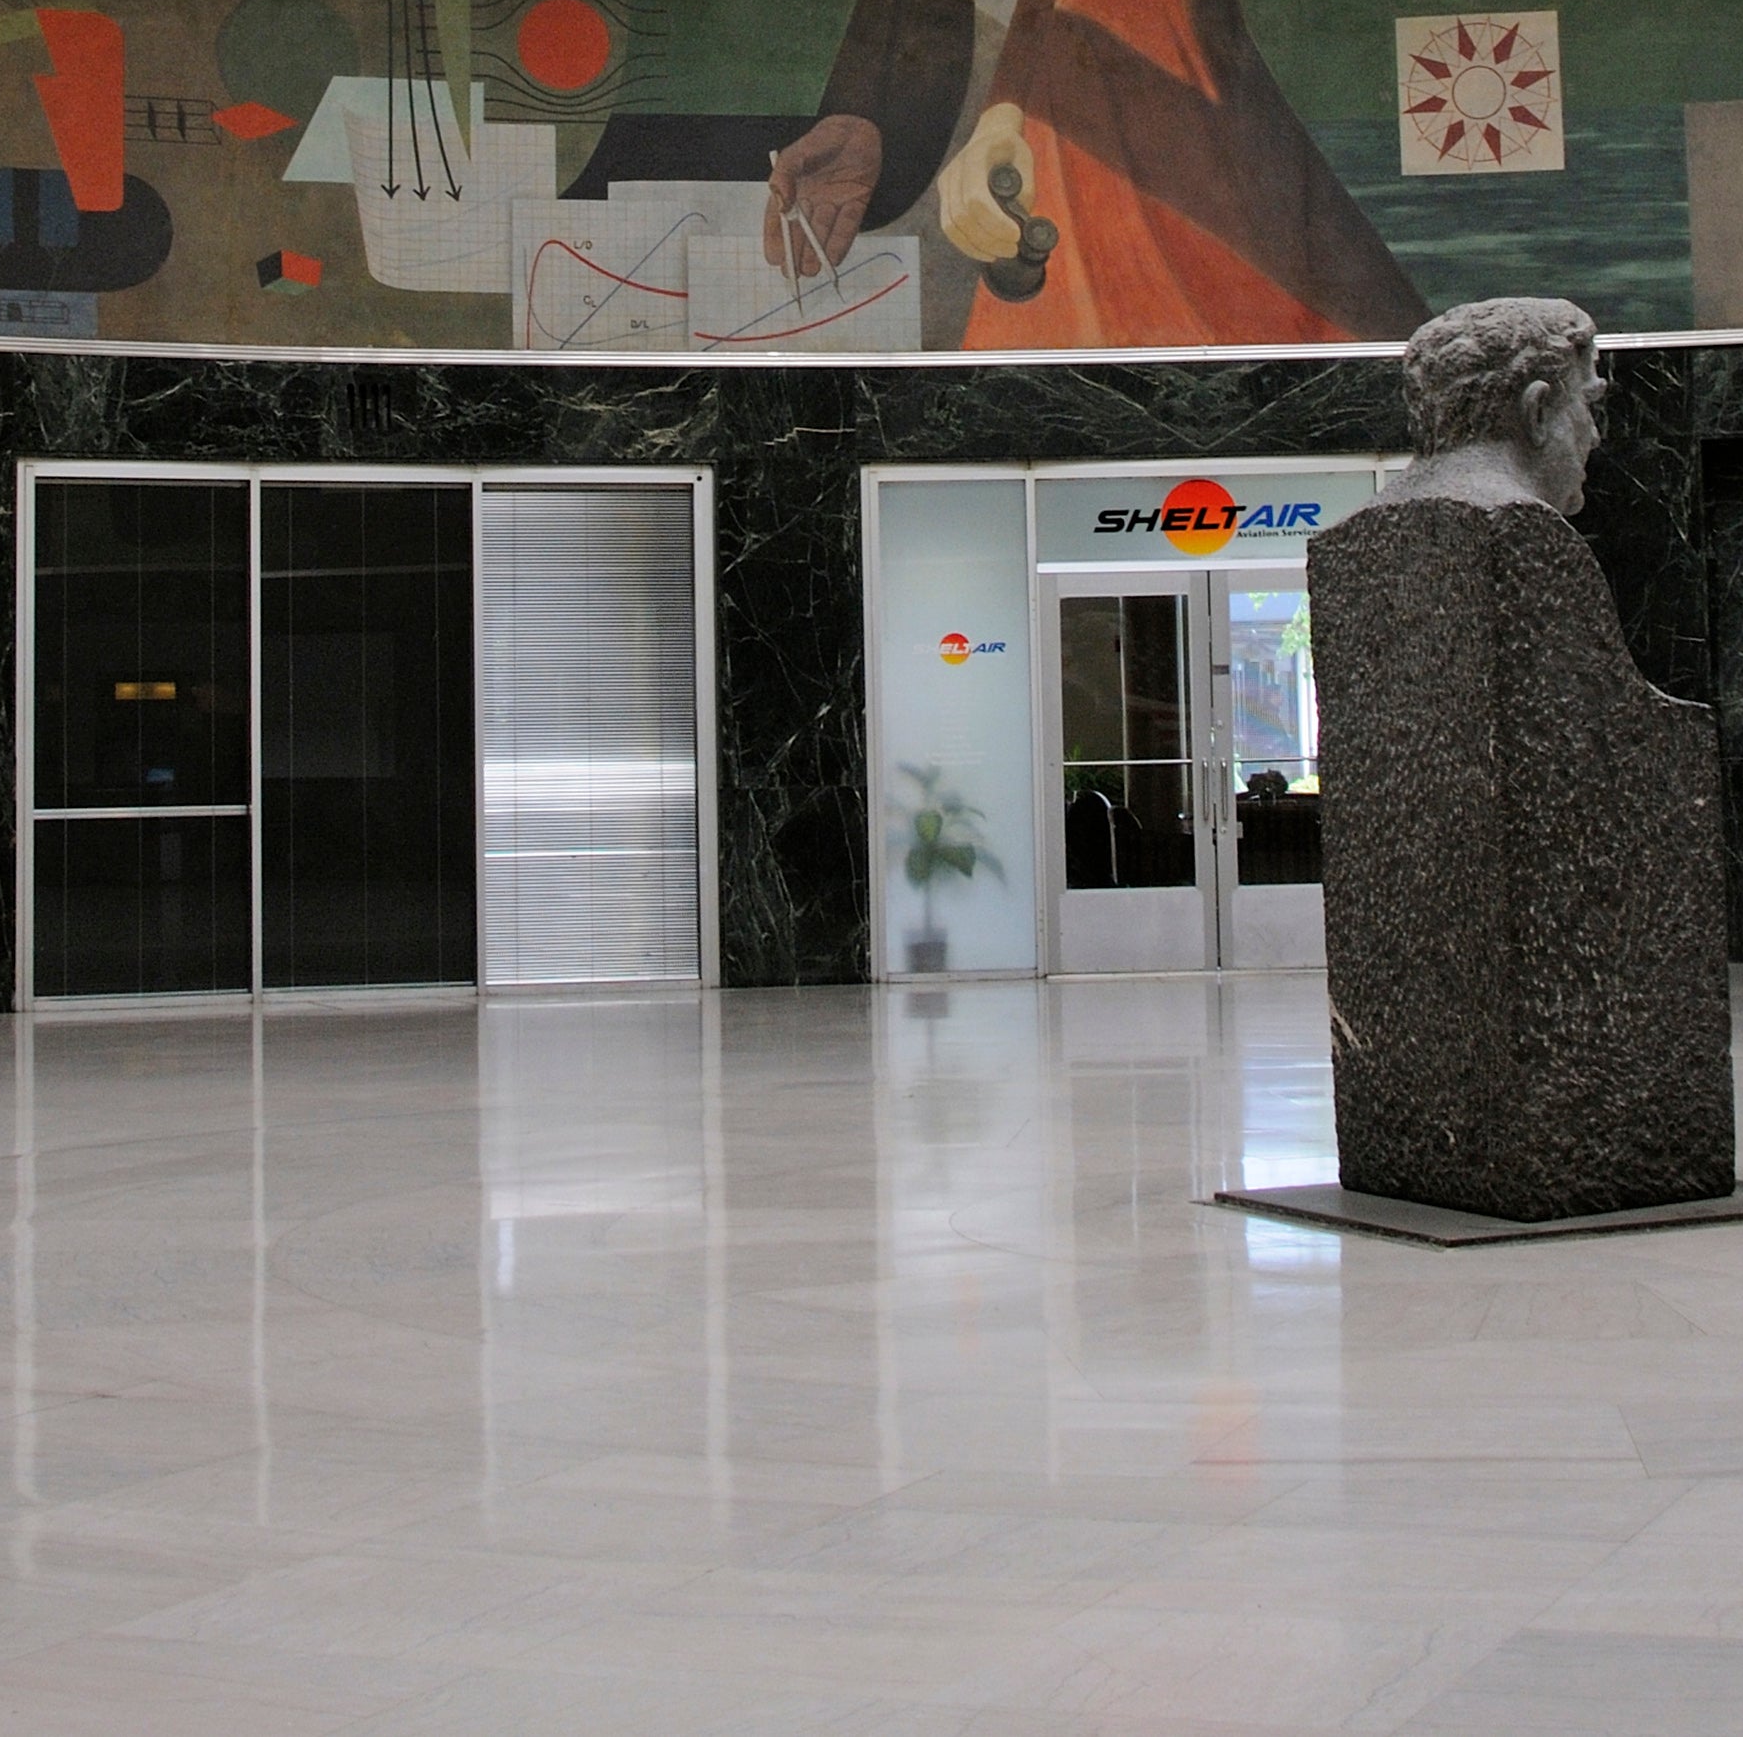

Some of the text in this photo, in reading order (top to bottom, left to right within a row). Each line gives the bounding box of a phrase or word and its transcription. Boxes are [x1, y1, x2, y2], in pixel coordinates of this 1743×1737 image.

[573, 240, 593, 251] L/D
[1094, 503, 1321, 533] SHELTAIR
[1237, 530, 1279, 538] Aviation
